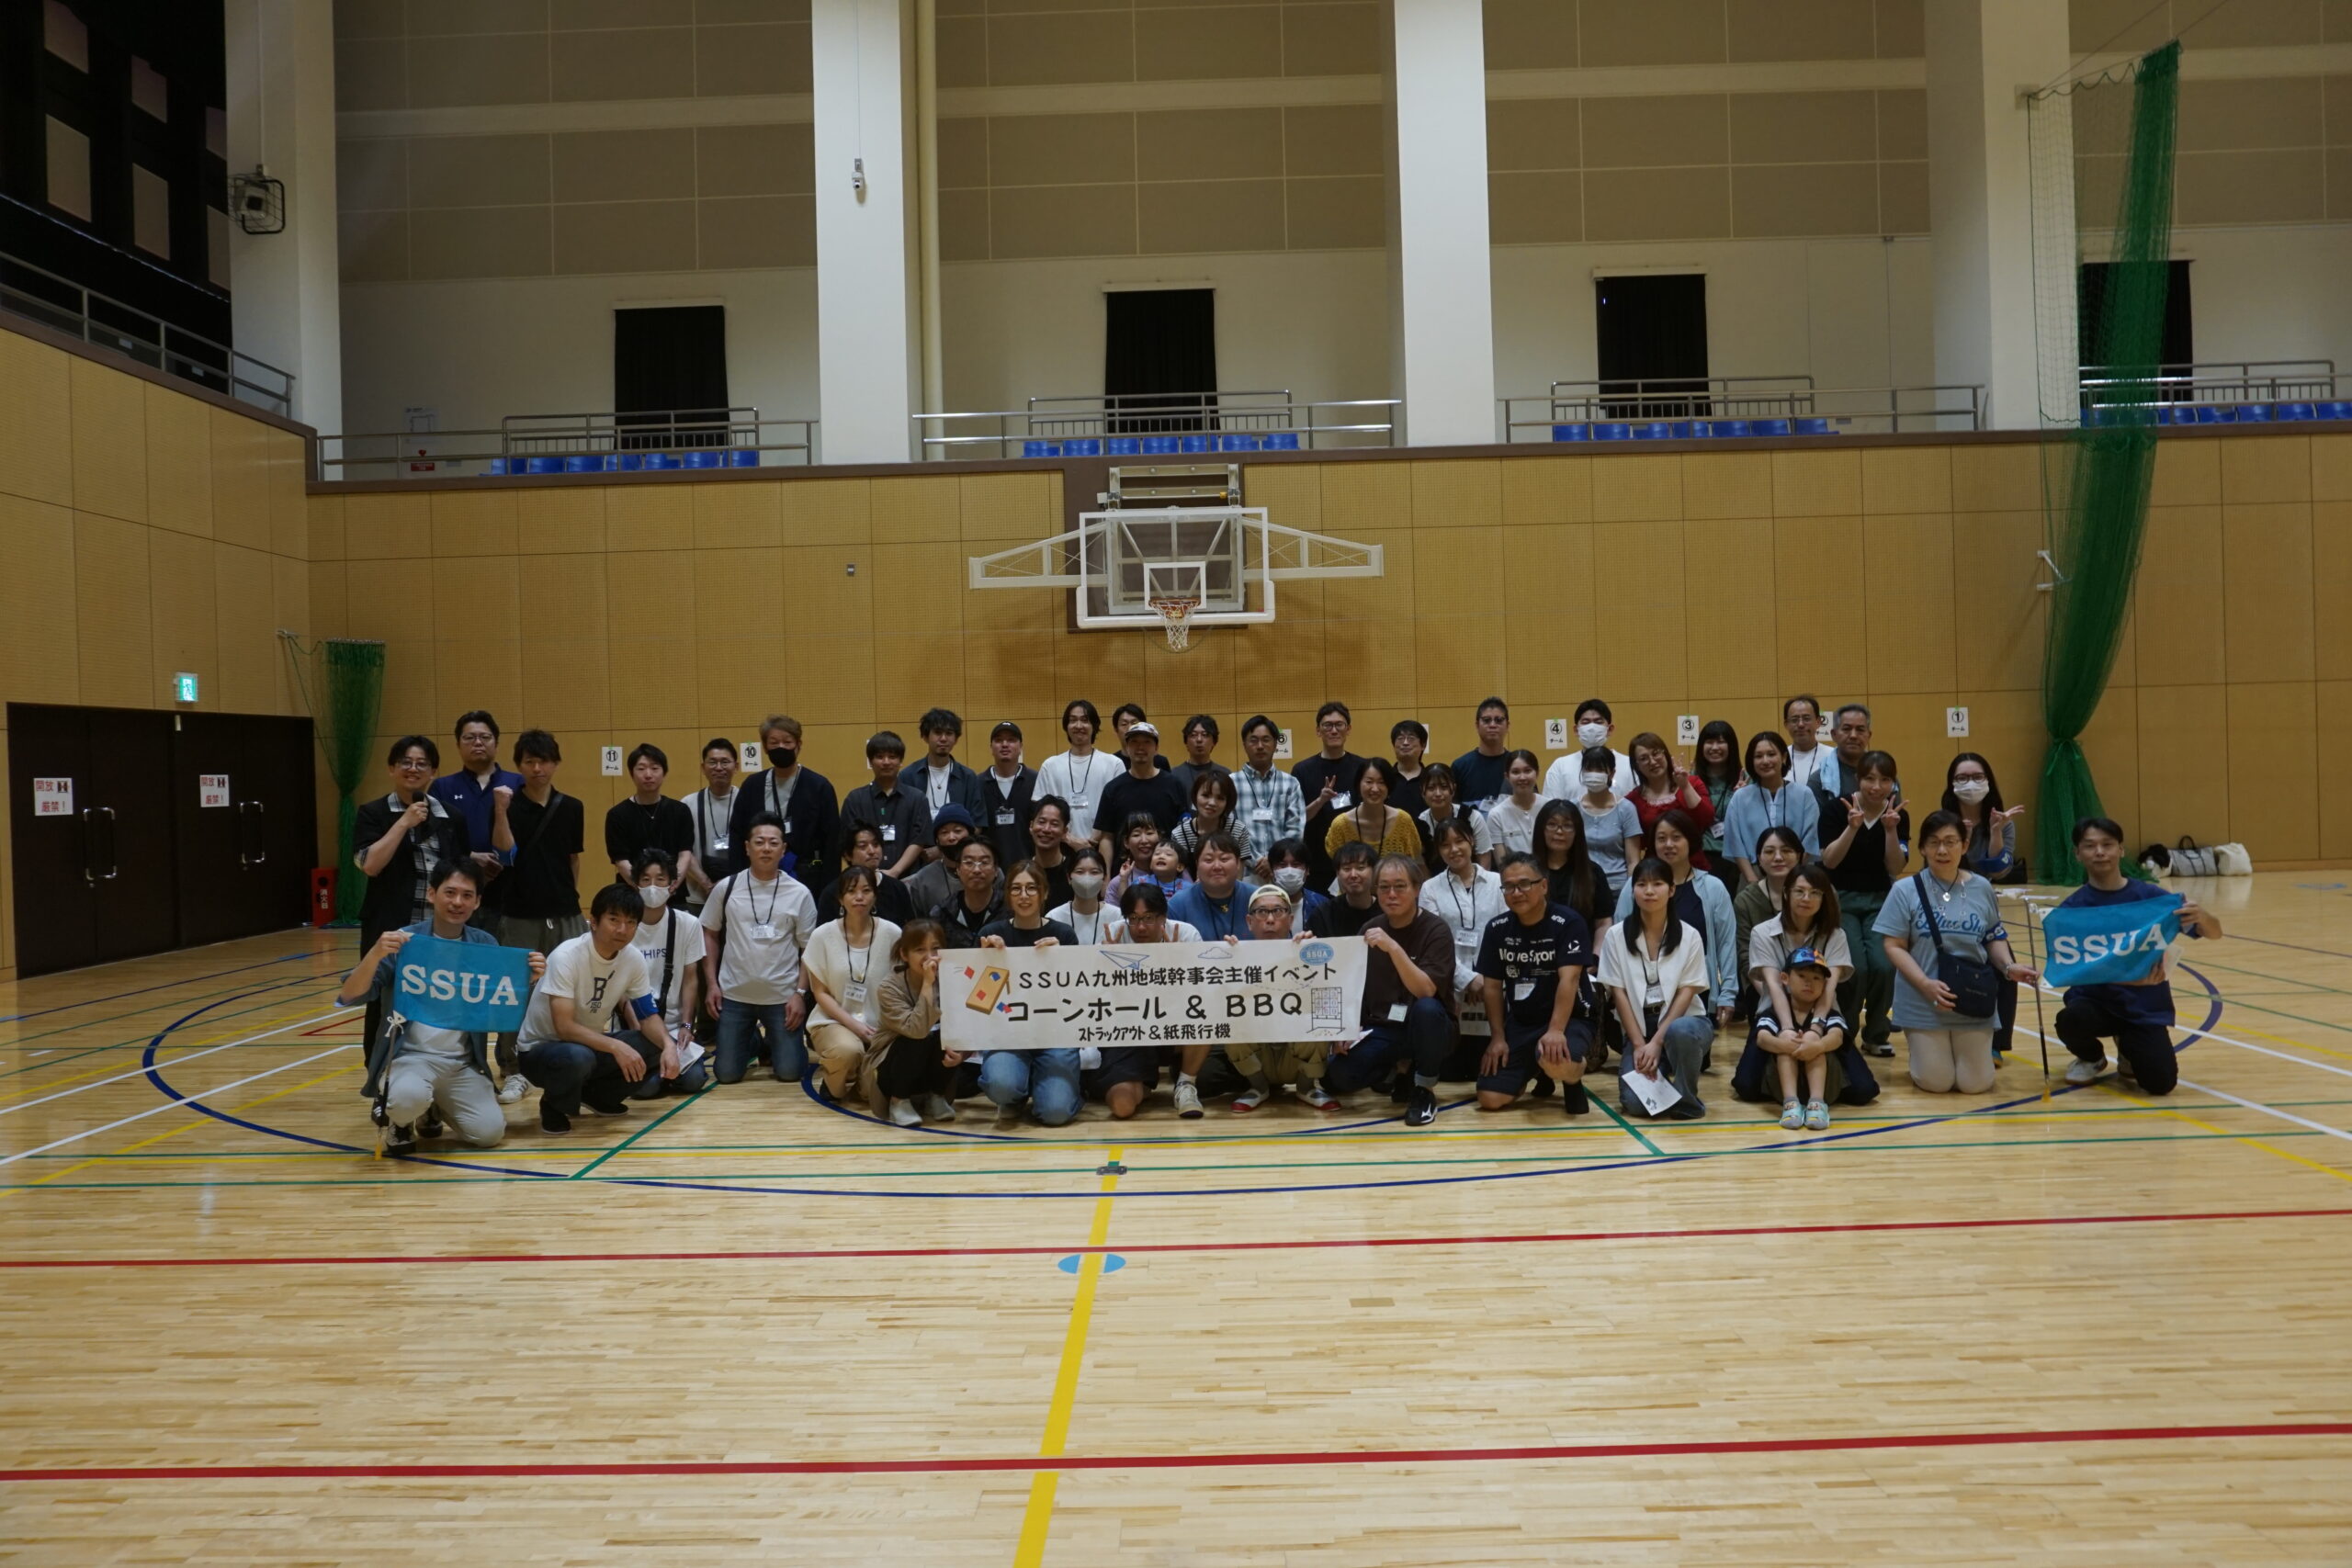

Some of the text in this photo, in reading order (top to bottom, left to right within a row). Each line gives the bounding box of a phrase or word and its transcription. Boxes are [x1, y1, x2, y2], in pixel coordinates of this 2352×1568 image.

[640, 948, 668, 960] HIPS
[2053, 923, 2168, 964] SSUA
[401, 964, 519, 1006] SSUA
[1008, 997, 1167, 1022] コーンホール
[1185, 995, 1207, 1020] &
[1226, 992, 1302, 1017] BBQ
